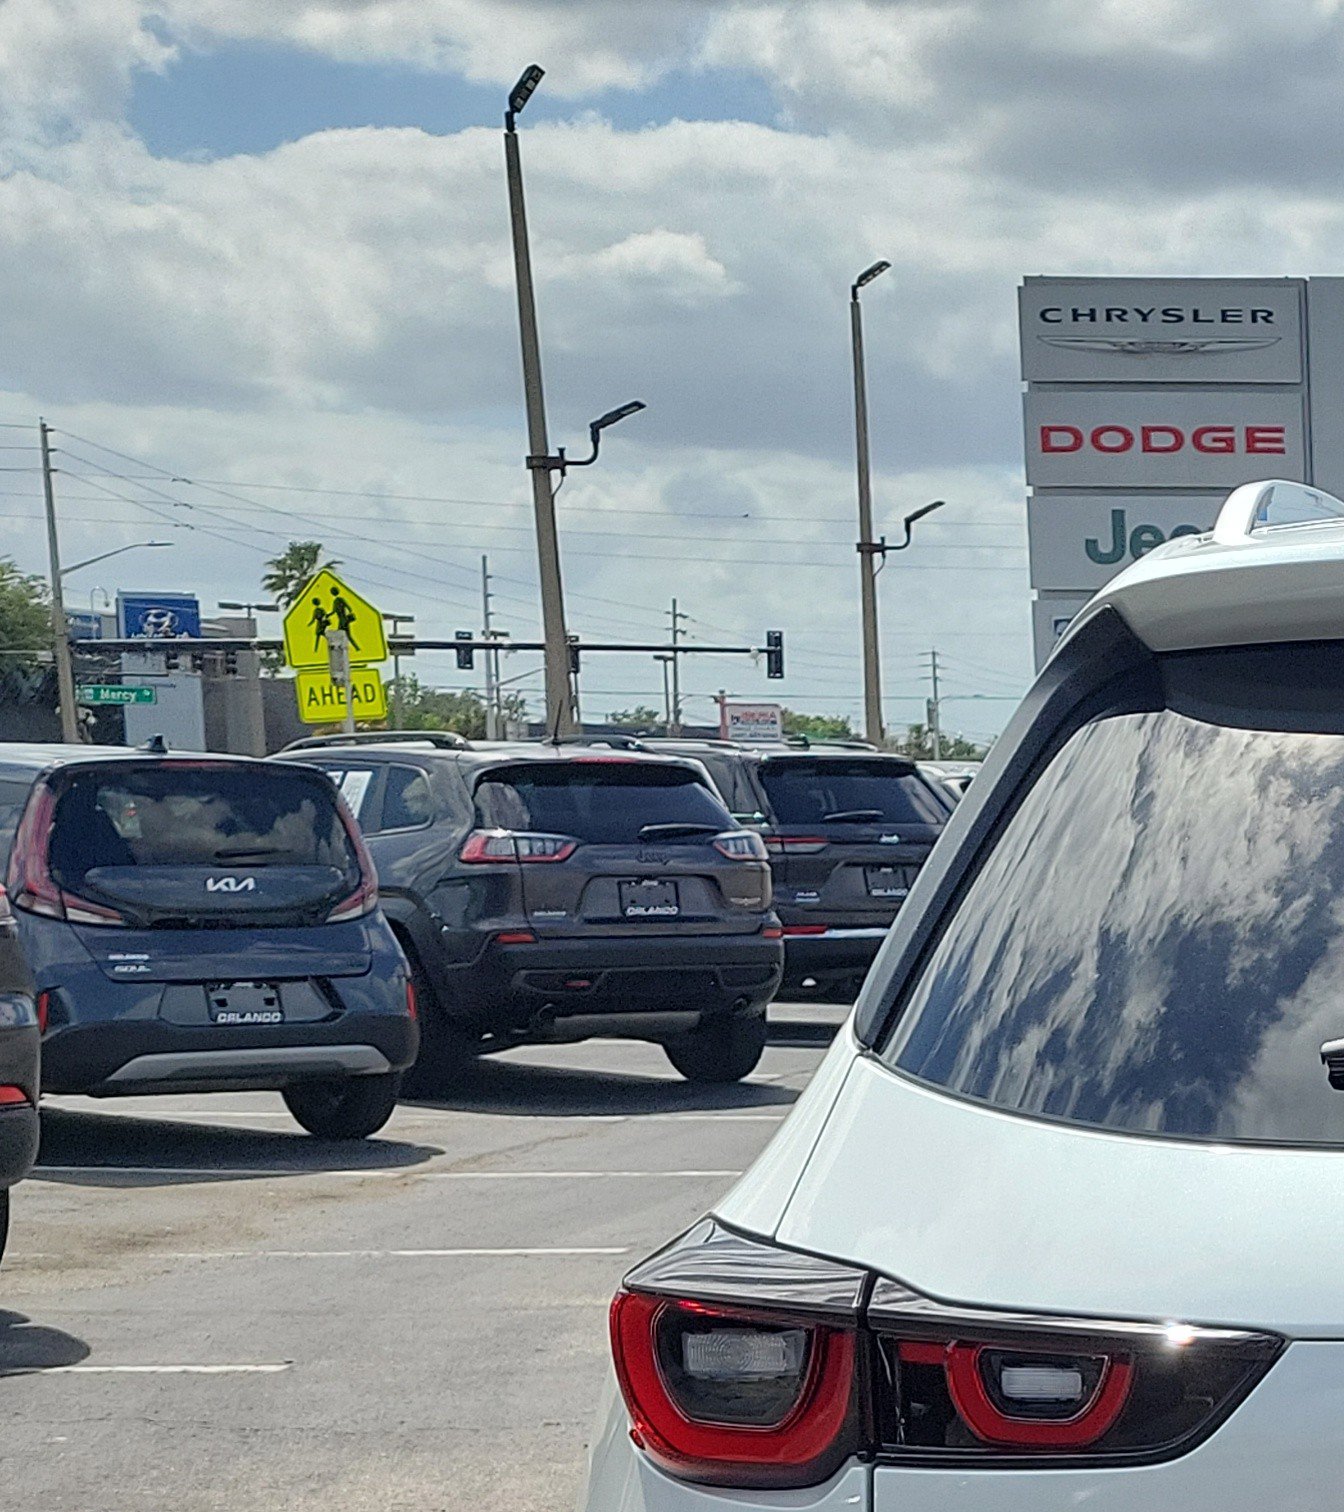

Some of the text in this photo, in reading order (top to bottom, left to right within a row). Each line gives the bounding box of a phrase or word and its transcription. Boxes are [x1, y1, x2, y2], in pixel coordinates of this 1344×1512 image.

[1039, 307, 1275, 324] CHRYSLER
[1040, 425, 1286, 454] DODGE
[1085, 509, 1203, 564] Je
[100, 688, 137, 704] Mercy
[307, 683, 376, 706] AHEAD
